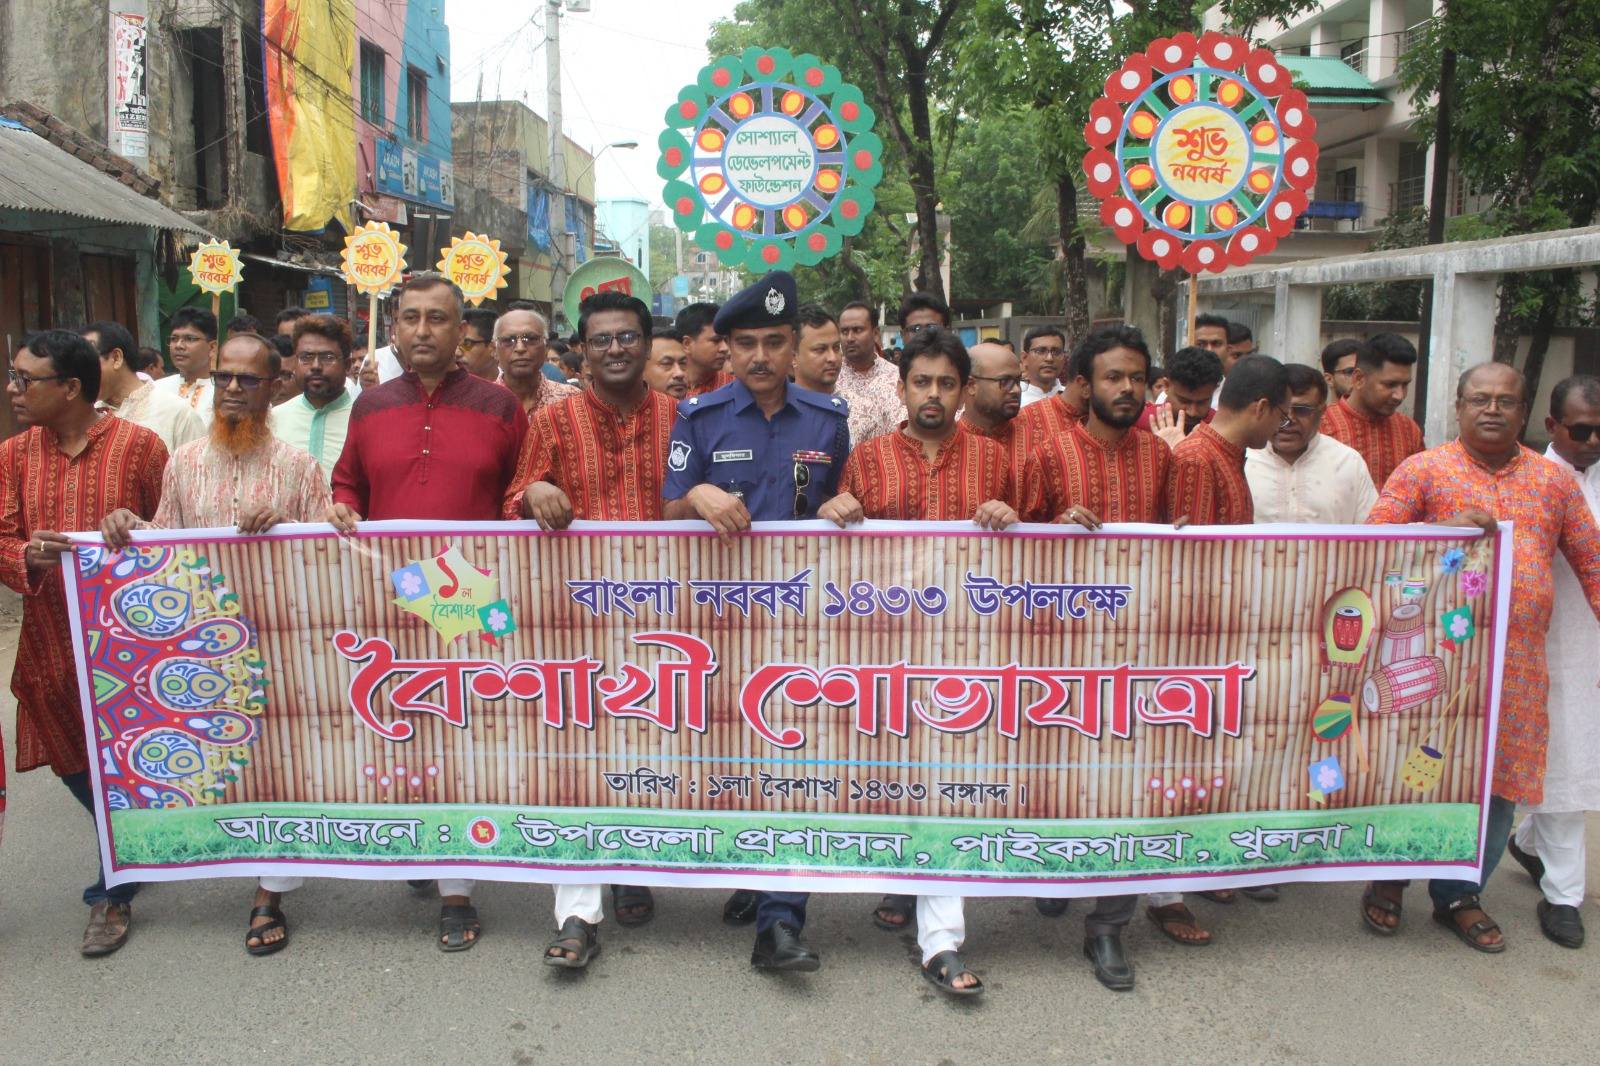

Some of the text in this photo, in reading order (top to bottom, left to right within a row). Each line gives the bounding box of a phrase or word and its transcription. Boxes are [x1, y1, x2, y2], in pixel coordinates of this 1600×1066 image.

[736, 130, 798, 145] সোশ্যাল
[1172, 127, 1229, 163] শুভ
[728, 148, 811, 171] ডেভেলপমেন্ট
[738, 173, 802, 193] ফাউন্ডেশন
[1168, 161, 1232, 184] নববর্ষ
[354, 242, 387, 261] শুভ
[455, 253, 489, 271] শুভ
[202, 253, 229, 273] শুভ
[353, 258, 391, 278] নববর্ষ
[197, 269, 234, 284] নববর্ষ
[453, 268, 492, 286] নববর্ষ
[566, 568, 1135, 621] বাংলা নববর্ষ ১৪৩৩ উপলক্ষে
[430, 593, 477, 631] বৈশাখ
[332, 629, 1258, 749] বৈশাখী শোভাযাত্রা
[602, 766, 681, 797] তারিখ
[706, 774, 753, 798] ১লা
[758, 769, 842, 800] বৈশাখ
[849, 778, 928, 801] ১৪৩৩
[936, 780, 1011, 805] বঙ্গাব্দ
[213, 813, 425, 848] আয়োজনে
[512, 813, 725, 856] উপজেলা
[1228, 822, 1352, 862] খুলনা
